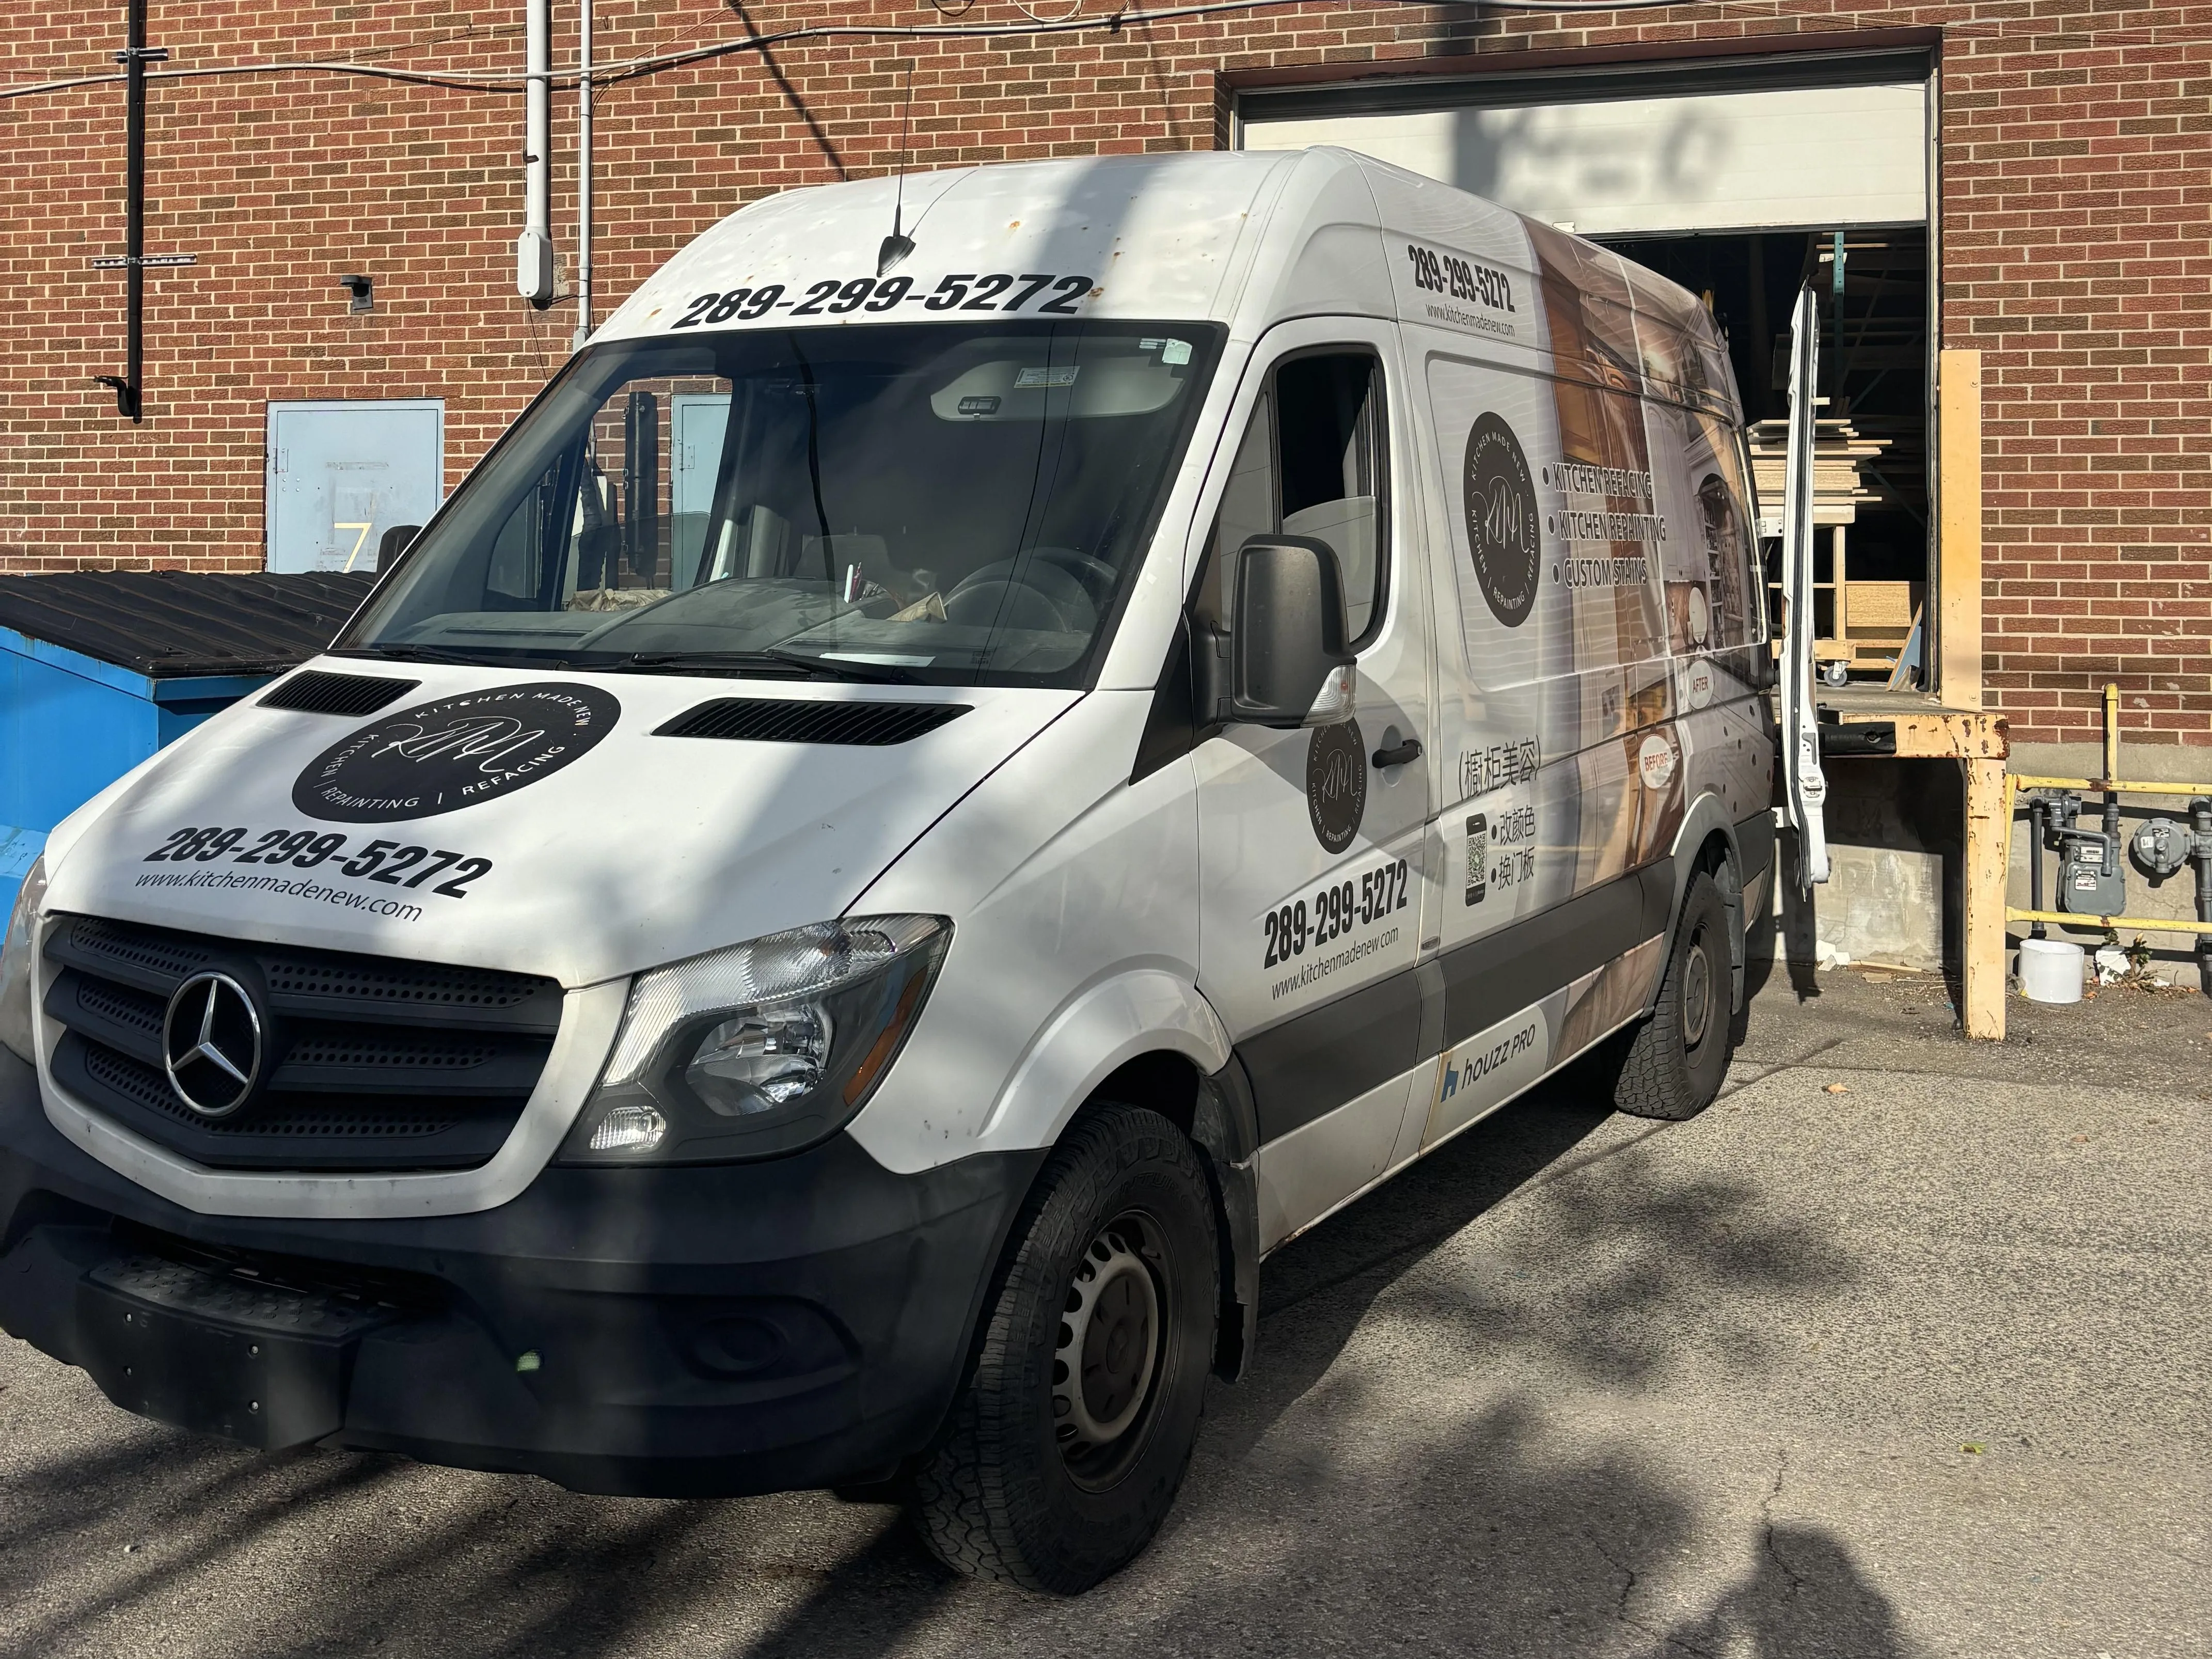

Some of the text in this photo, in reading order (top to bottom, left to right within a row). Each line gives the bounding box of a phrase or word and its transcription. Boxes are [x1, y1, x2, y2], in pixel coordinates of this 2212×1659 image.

[670, 274, 1094, 329] 289-299-5272
[1408, 245, 1515, 312] 289-299-5272
[1425, 303, 1515, 337] www.kitchenmadenew.com
[1471, 430, 1525, 482] KITCHEN MADE NEW
[1552, 462, 1653, 499] KITCHEN REFACING
[334, 523, 372, 573] 7
[1558, 510, 1666, 541] KITCHEN REPAINTING
[1471, 509, 1488, 574] KITCHEN
[1493, 587, 1525, 610] REPAINTING
[1563, 557, 1647, 589] CUSTOM STAINS
[1692, 676, 1709, 693] AFTER
[415, 692, 592, 726] KITCHEN MADE NEW
[321, 734, 566, 809] KITCHEN REPAINTING REFACING
[1644, 752, 1668, 772] BEFORE
[1499, 804, 1535, 846] 改颜色
[143, 827, 493, 899] 289-299-5272
[1498, 846, 1535, 890] 换门板
[135, 870, 422, 922] www.kitchenmadenew.com
[1264, 859, 1408, 970] 289-299-5272
[1272, 927, 1398, 1001] www.kitchenmadenewcom
[1511, 1023, 1536, 1058] PRO
